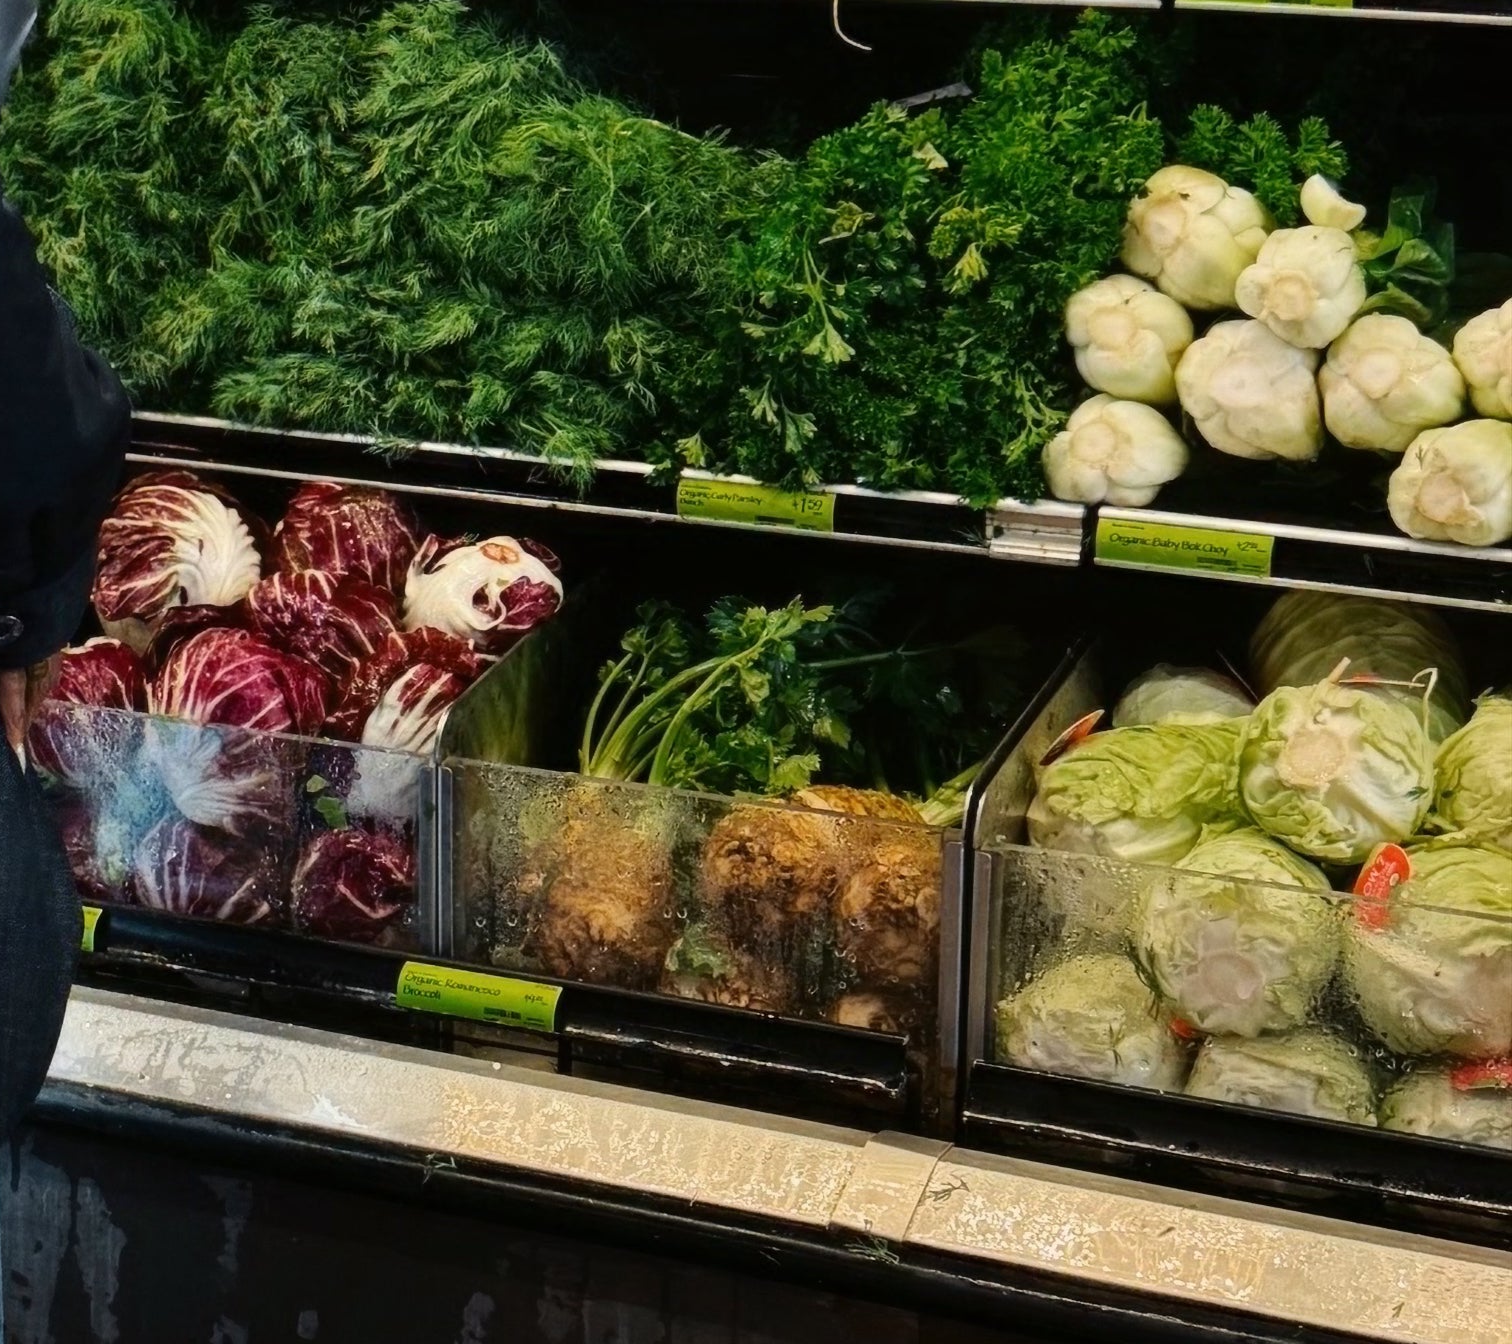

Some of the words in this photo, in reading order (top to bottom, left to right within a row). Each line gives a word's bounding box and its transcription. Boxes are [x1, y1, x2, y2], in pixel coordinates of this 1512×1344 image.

[679, 488, 711, 501] Organic
[711, 492, 733, 503] Curly
[732, 493, 763, 506] Parsley
[1109, 532, 1151, 546] Organic
[1151, 536, 1181, 551] Baby
[1181, 540, 1202, 551] Bok
[1202, 542, 1229, 557] Choy
[402, 984, 442, 1001] Broccoli
[404, 971, 444, 987] Organic
[443, 977, 501, 997] Romanesco
